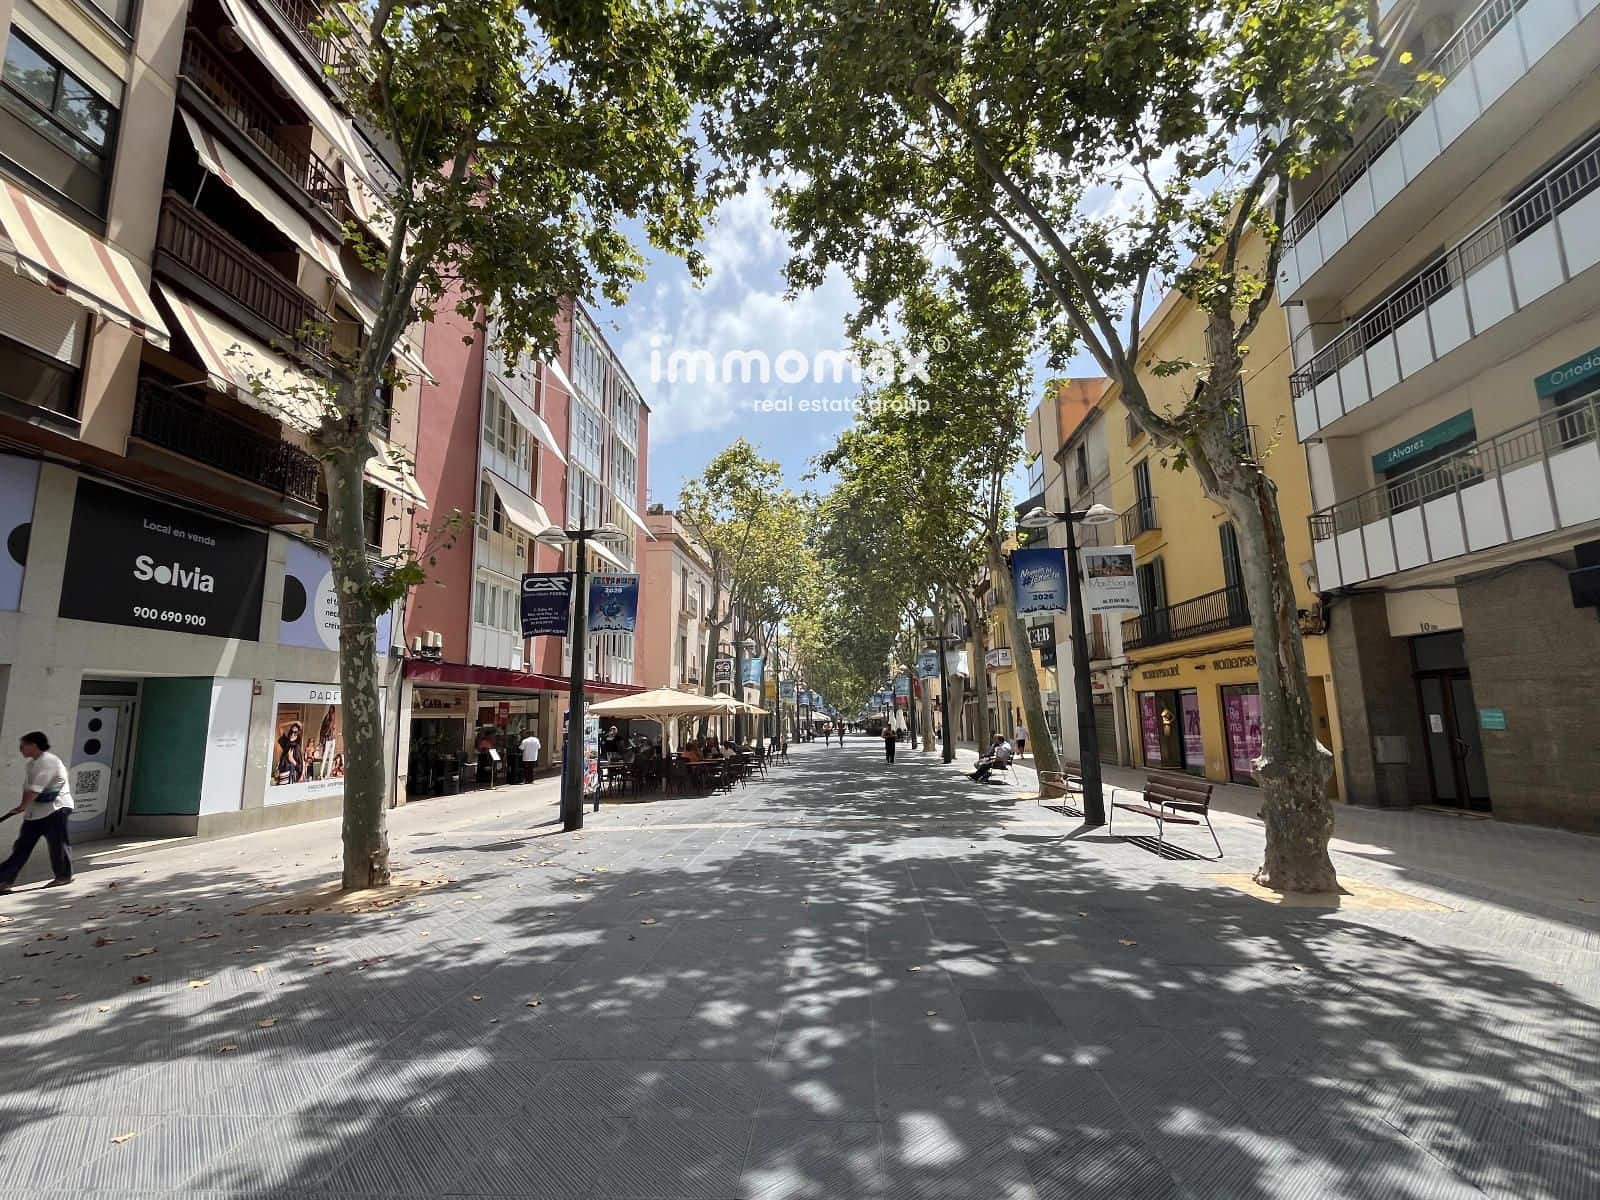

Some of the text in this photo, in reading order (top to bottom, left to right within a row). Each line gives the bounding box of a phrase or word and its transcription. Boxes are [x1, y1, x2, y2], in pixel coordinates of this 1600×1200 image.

[143, 518, 216, 546] Local en venda
[133, 555, 214, 593] Solvia
[133, 606, 206, 626] 900 690 900
